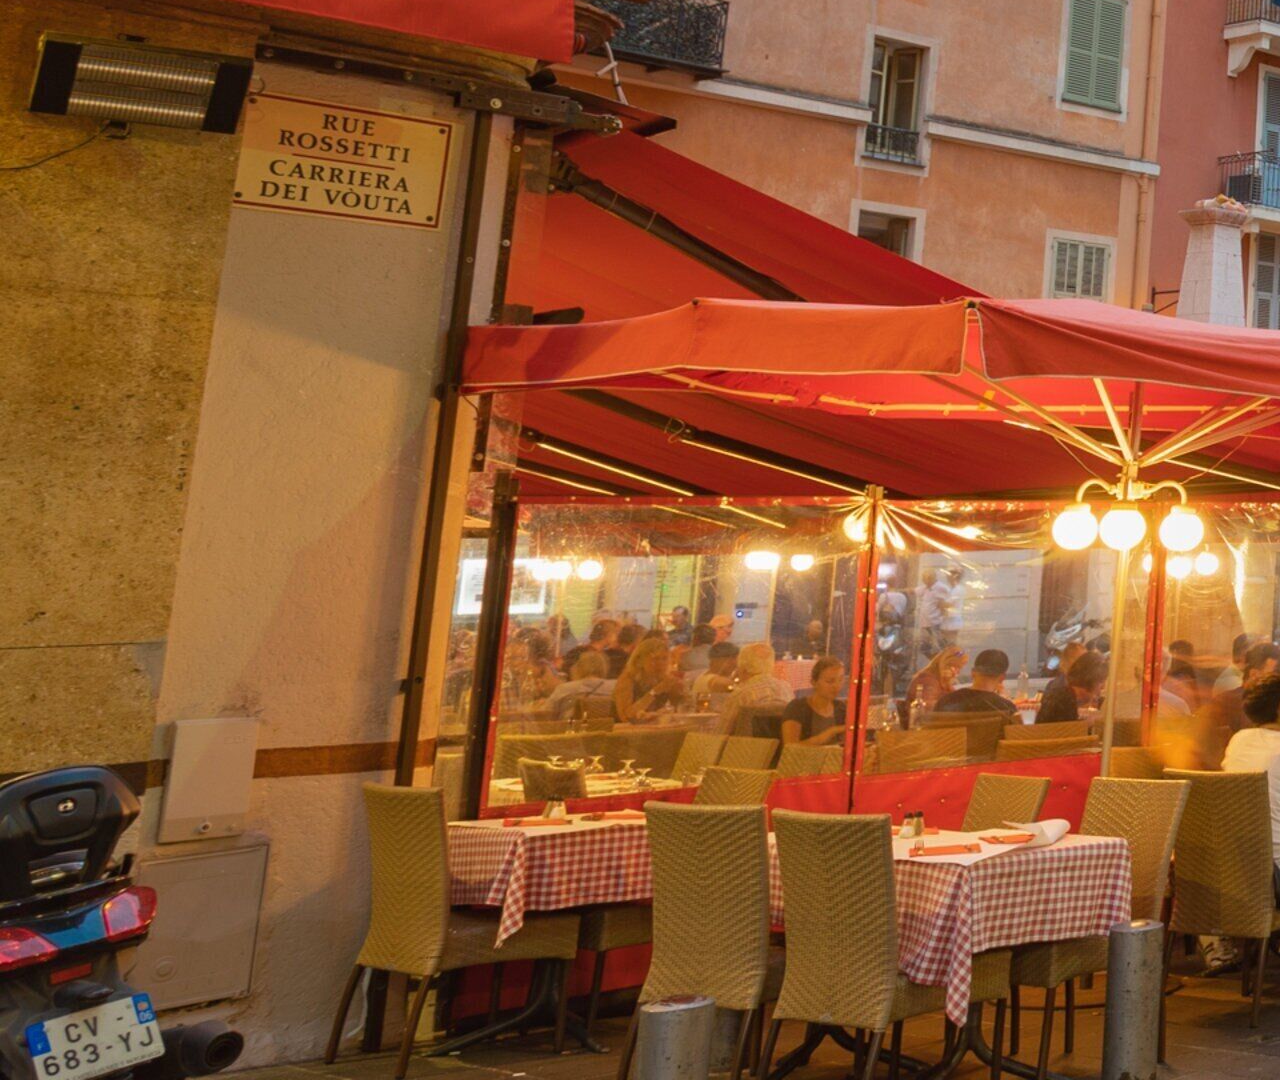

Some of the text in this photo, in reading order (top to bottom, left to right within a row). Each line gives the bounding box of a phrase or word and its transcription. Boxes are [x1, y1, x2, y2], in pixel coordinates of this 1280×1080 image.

[322, 113, 376, 136] RUE
[278, 129, 411, 163] ROSSETTI
[269, 159, 410, 193] CARRIERA
[259, 180, 413, 215] DEI VÒUTA
[43, 1026, 154, 1076] 683-YJ
